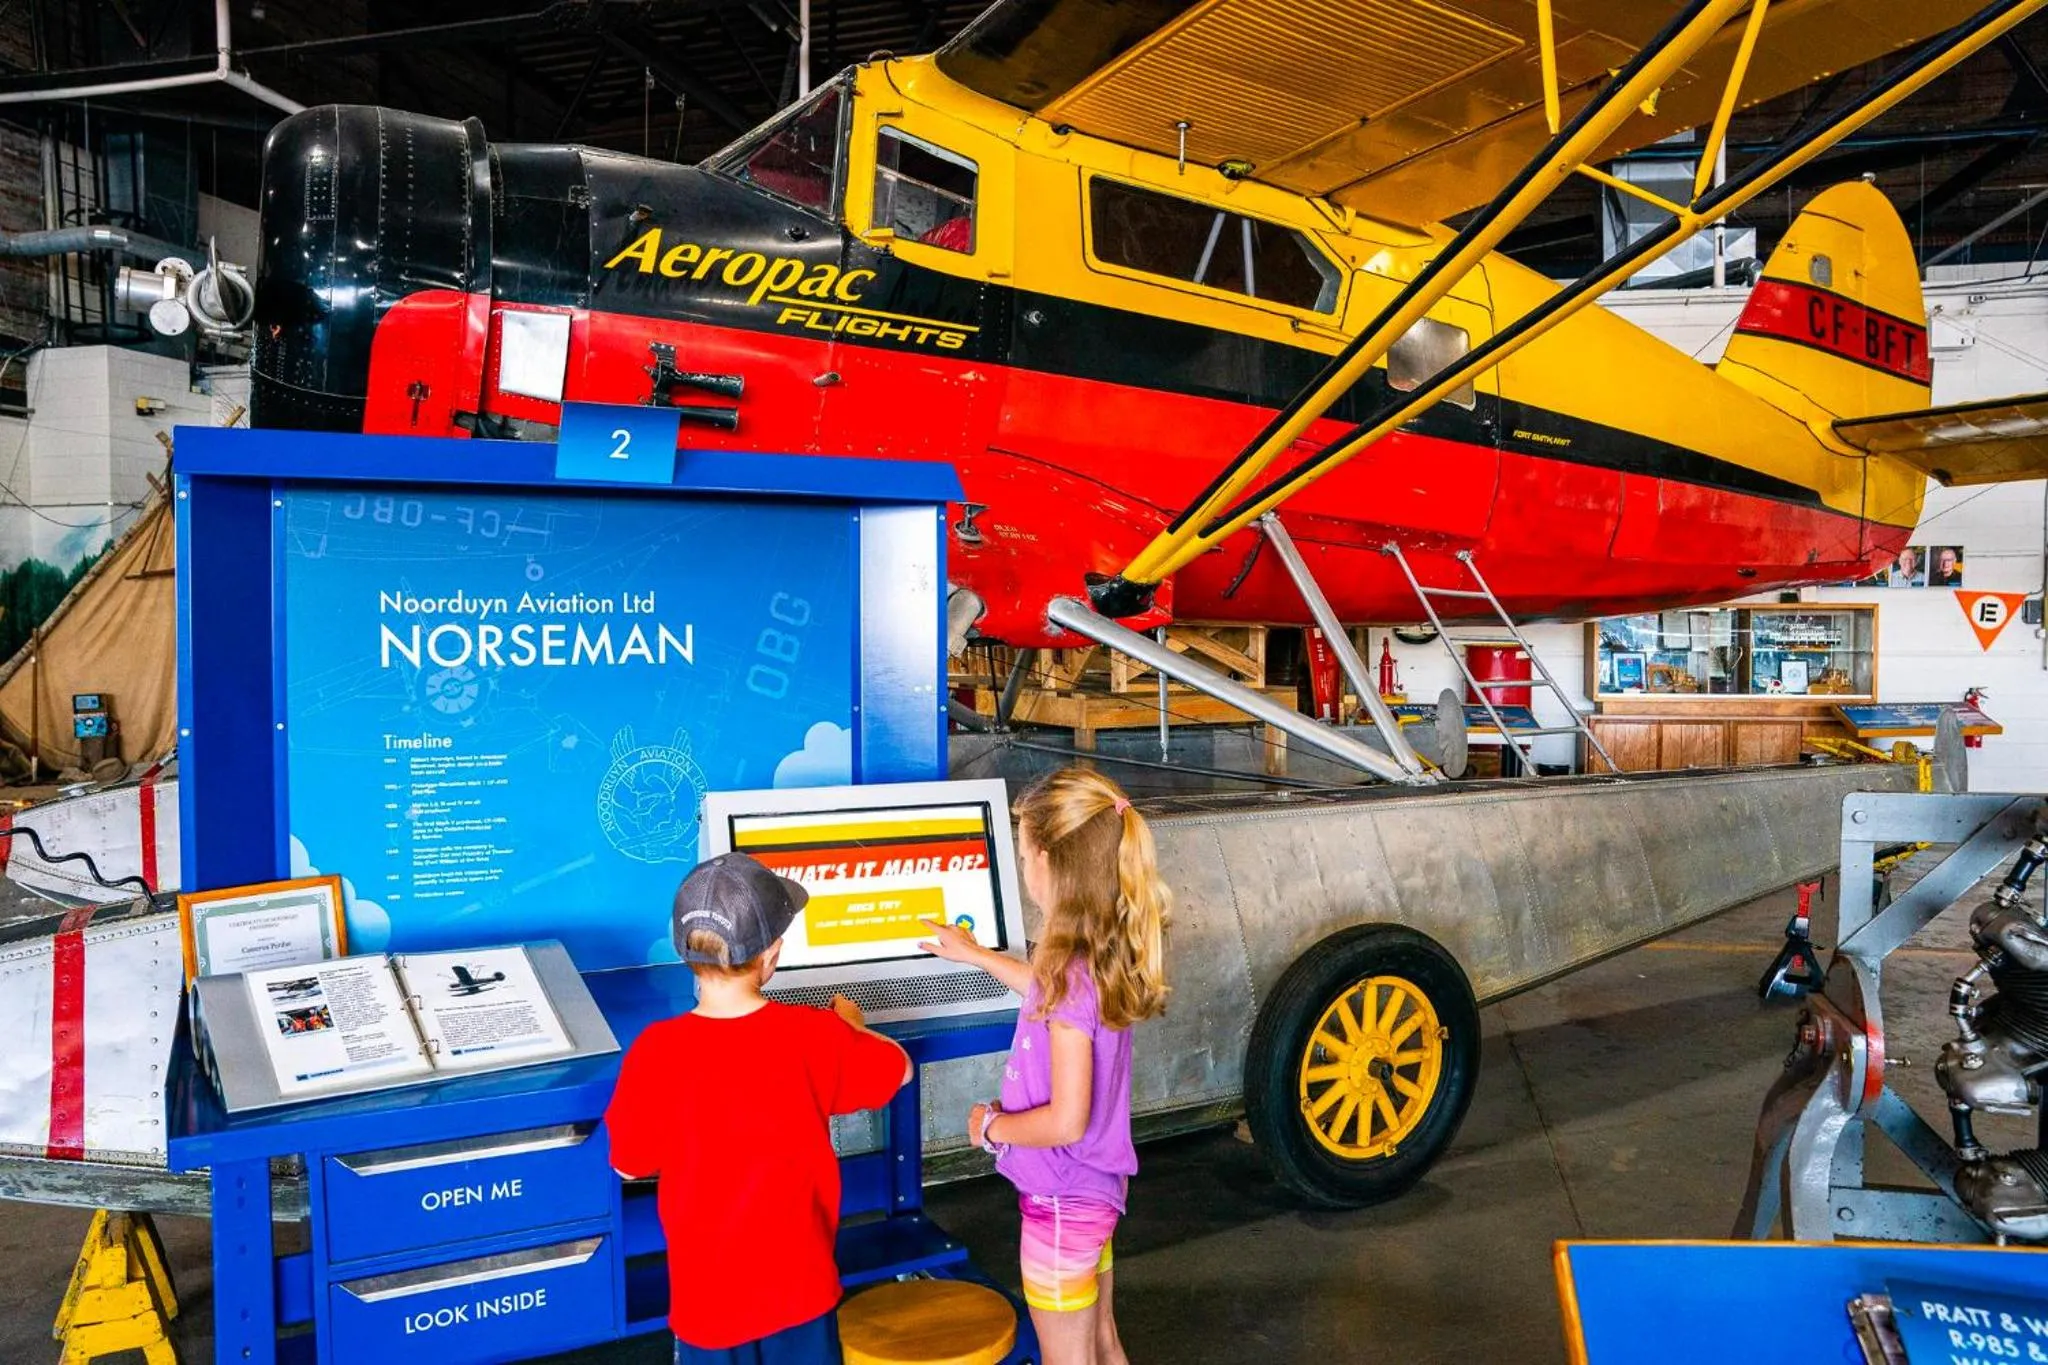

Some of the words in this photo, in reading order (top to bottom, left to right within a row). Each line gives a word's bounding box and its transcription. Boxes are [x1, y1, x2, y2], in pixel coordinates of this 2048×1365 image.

[604, 227, 876, 306] Aeropac
[775, 308, 968, 349] FLIGHTS
[1808, 295, 1916, 370] CF-BFT
[609, 429, 631, 459] 2
[1512, 429, 1532, 439] FORT
[380, 589, 508, 620] Noorduyn
[516, 590, 614, 614] Aviation
[622, 591, 655, 614] Ltd
[1979, 603, 1999, 622] E
[380, 622, 694, 669] NORSEMAN
[383, 732, 452, 750] Timeline
[640, 750, 694, 773] AVIATION
[770, 862, 848, 883] WHAT'S
[853, 860, 877, 879] IT
[880, 856, 942, 877] MADE
[946, 853, 985, 872] OF?
[421, 1185, 483, 1211] OPEN
[491, 1179, 522, 1200] ME
[405, 1304, 469, 1334] LOOK
[476, 1288, 547, 1319] INSIDE
[1921, 1301, 1992, 1329] PRATT
[1999, 1312, 2021, 1334] &
[2027, 1341, 2048, 1363] &
